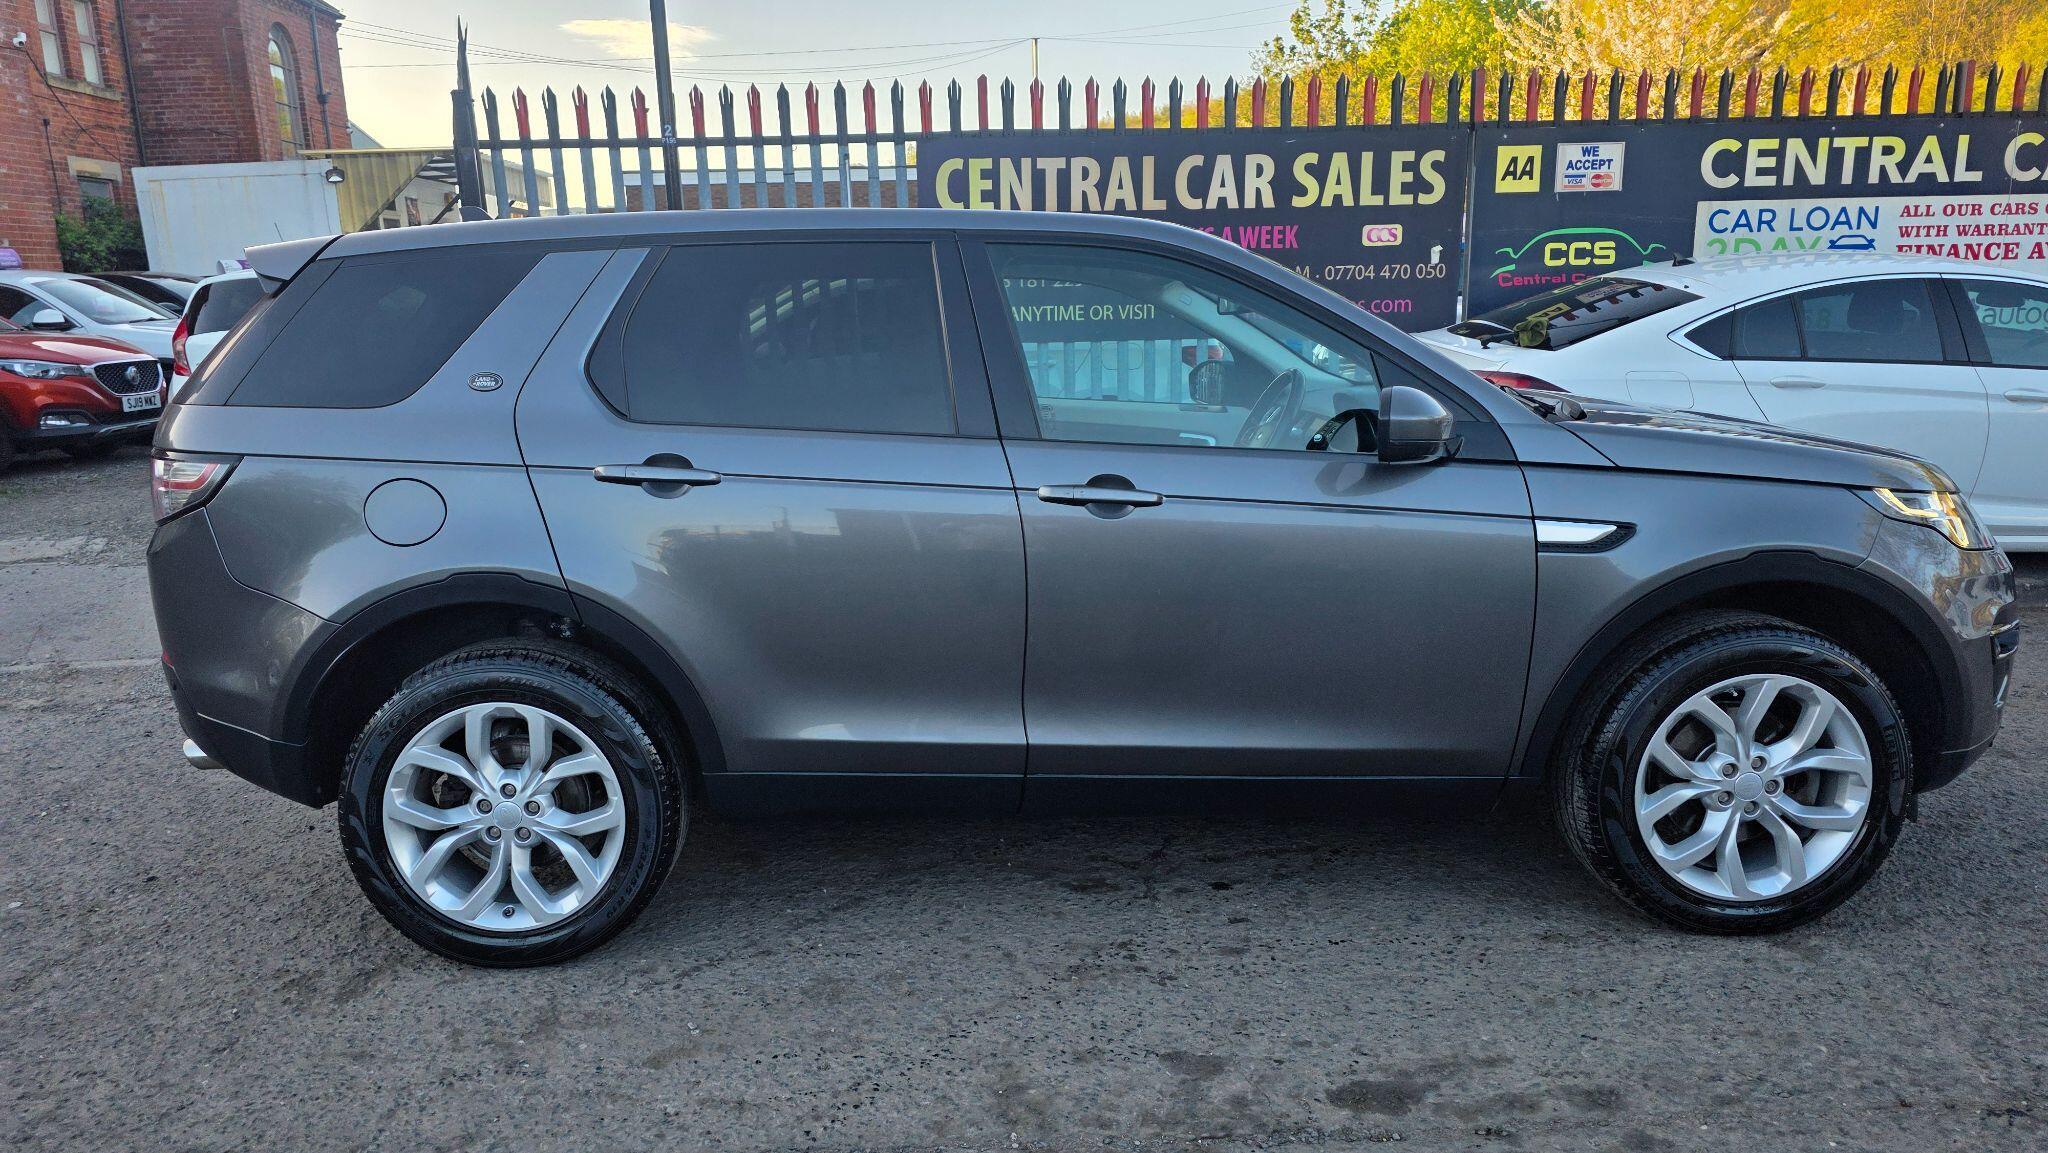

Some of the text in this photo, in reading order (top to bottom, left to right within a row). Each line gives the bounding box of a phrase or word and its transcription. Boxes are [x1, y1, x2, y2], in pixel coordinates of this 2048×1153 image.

[1581, 145, 1600, 158] WE
[1700, 132, 2048, 189] CENTRAL C
[1500, 155, 1535, 182] AA
[1565, 158, 1614, 171] ACCEPT
[935, 149, 1446, 212] CENTRAL CAR SALES
[1899, 204, 1936, 218] ALL
[1942, 203, 1984, 217] OUR
[1989, 202, 2040, 216] CARS
[1707, 205, 1880, 234] CAR LOAN
[1238, 224, 1300, 249] WEEK
[1897, 222, 2048, 238] WITH WARRANT
[1543, 240, 1616, 267] CCS
[1324, 264, 1376, 281] 07704
[1380, 264, 1410, 280] 470
[1415, 263, 1446, 279] 050
[1497, 272, 1566, 288] Central
[1011, 304, 1085, 322] ANYTIME
[1089, 304, 1113, 321] OR
